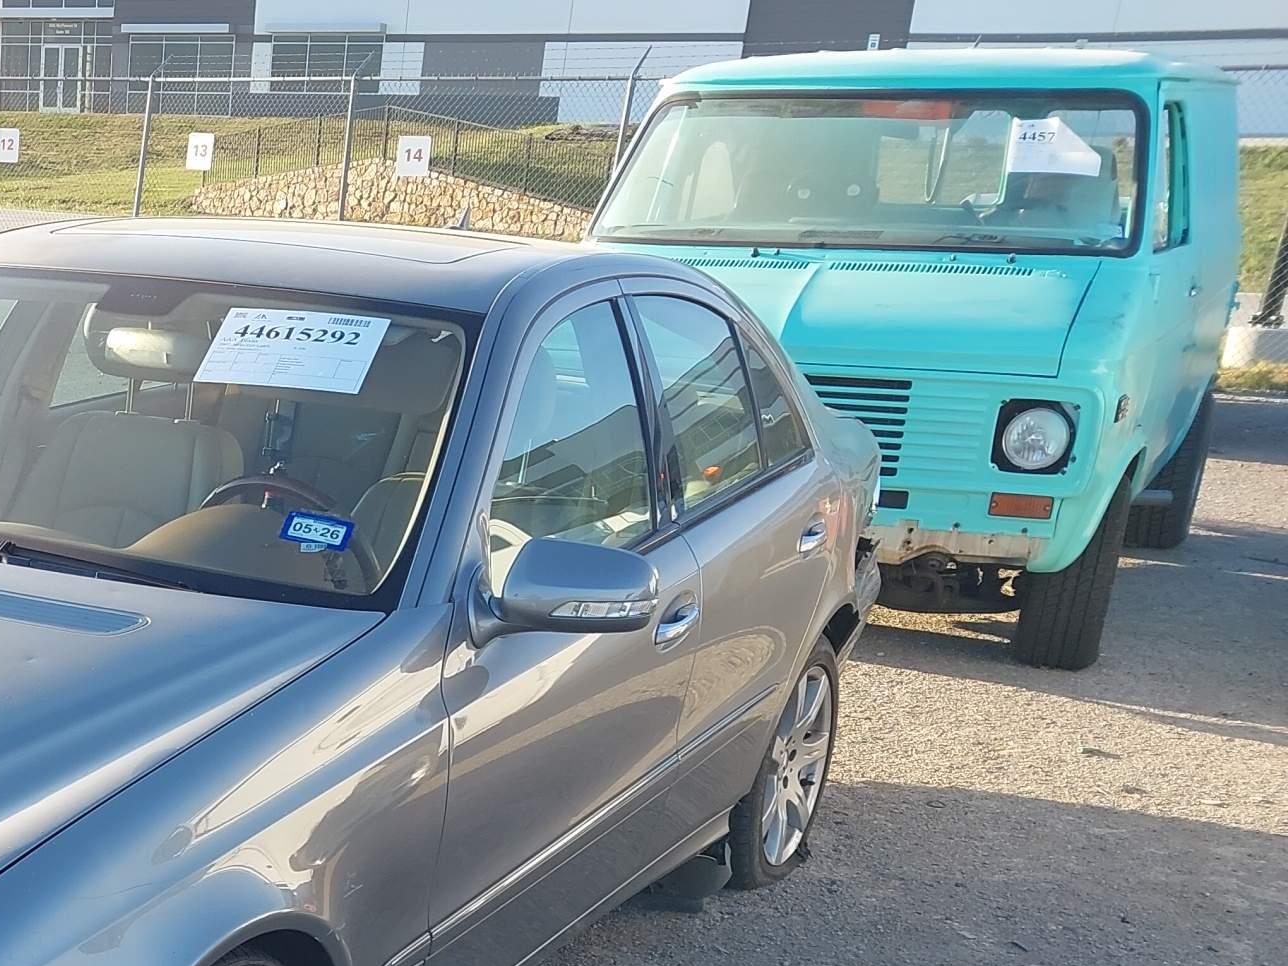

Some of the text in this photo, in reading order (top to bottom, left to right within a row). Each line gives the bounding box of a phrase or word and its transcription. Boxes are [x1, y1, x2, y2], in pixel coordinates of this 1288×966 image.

[0, 138, 15, 151] 12
[193, 144, 208, 157] 13
[404, 148, 424, 162] 14
[233, 324, 361, 346] 44615292
